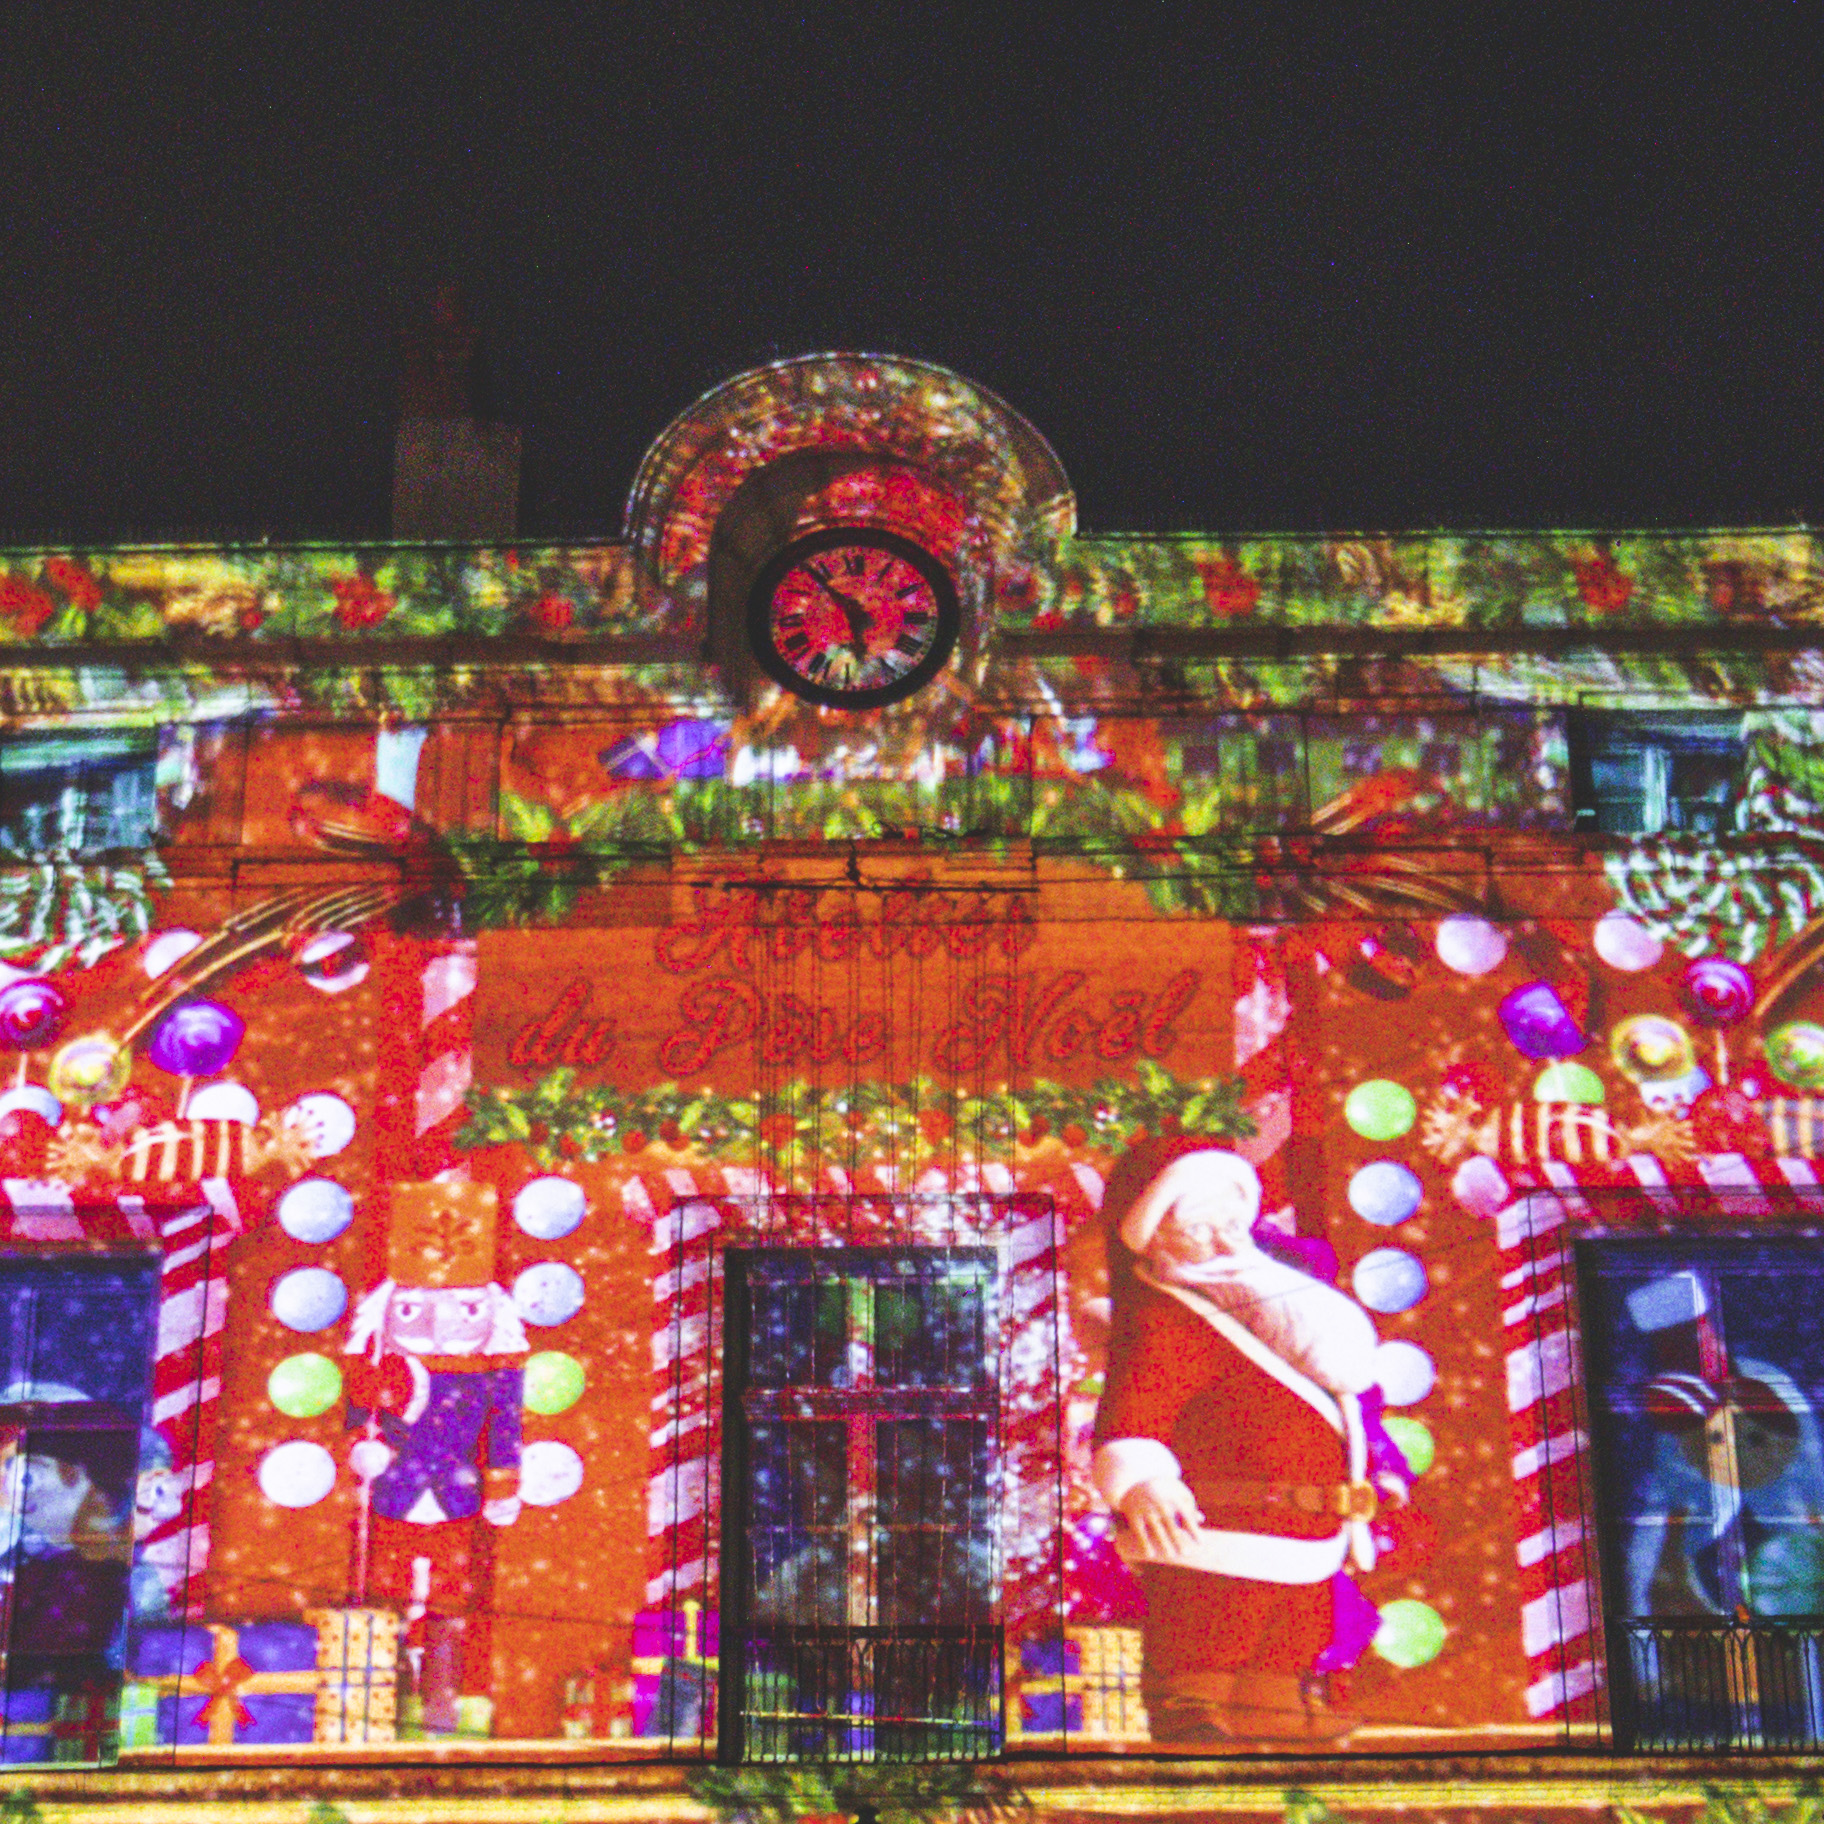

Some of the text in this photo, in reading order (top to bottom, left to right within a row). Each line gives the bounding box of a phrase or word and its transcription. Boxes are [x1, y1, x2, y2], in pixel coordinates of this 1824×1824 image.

[508, 969, 1202, 1078] du Père Noël
